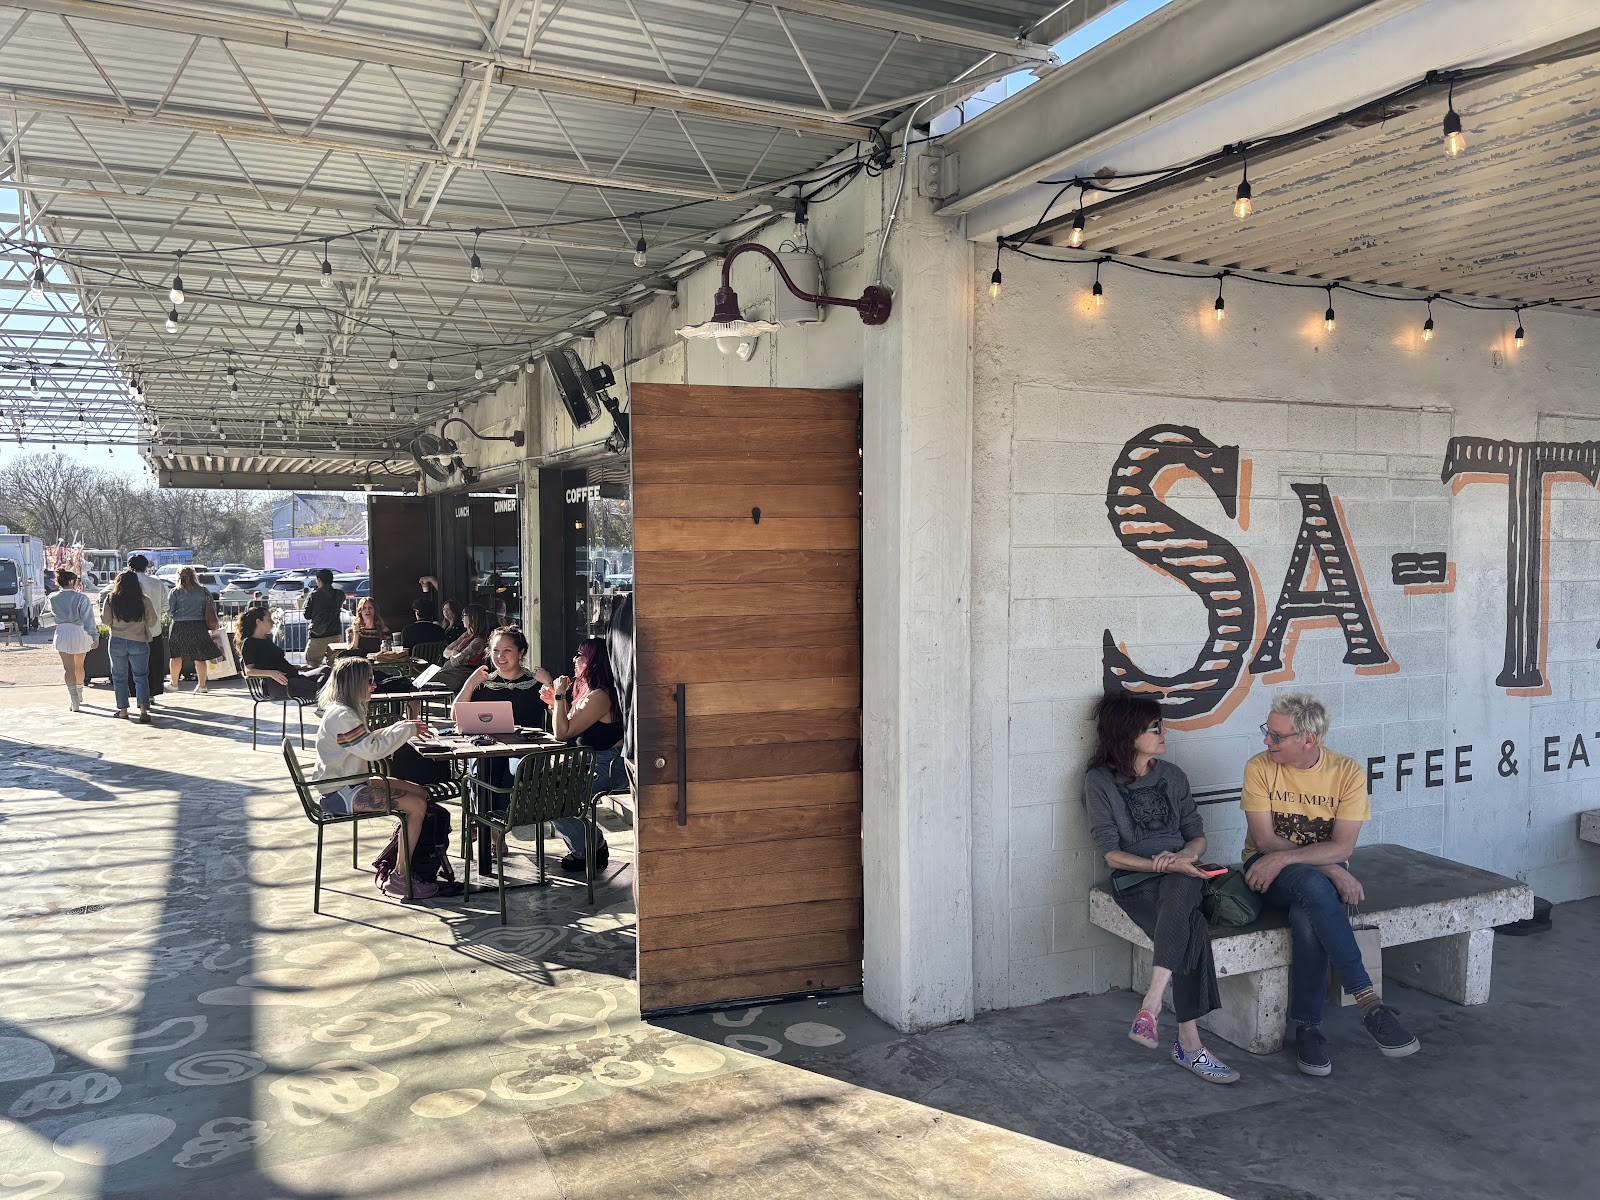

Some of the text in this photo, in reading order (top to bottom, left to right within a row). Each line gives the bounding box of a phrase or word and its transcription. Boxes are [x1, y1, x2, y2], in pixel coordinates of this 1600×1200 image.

[565, 485, 601, 504] COFFEE
[455, 506, 470, 518] LUNCH
[494, 499, 517, 513] DINNER
[1104, 423, 1600, 730] SA-T
[1367, 732, 1600, 795] FFEE & EA
